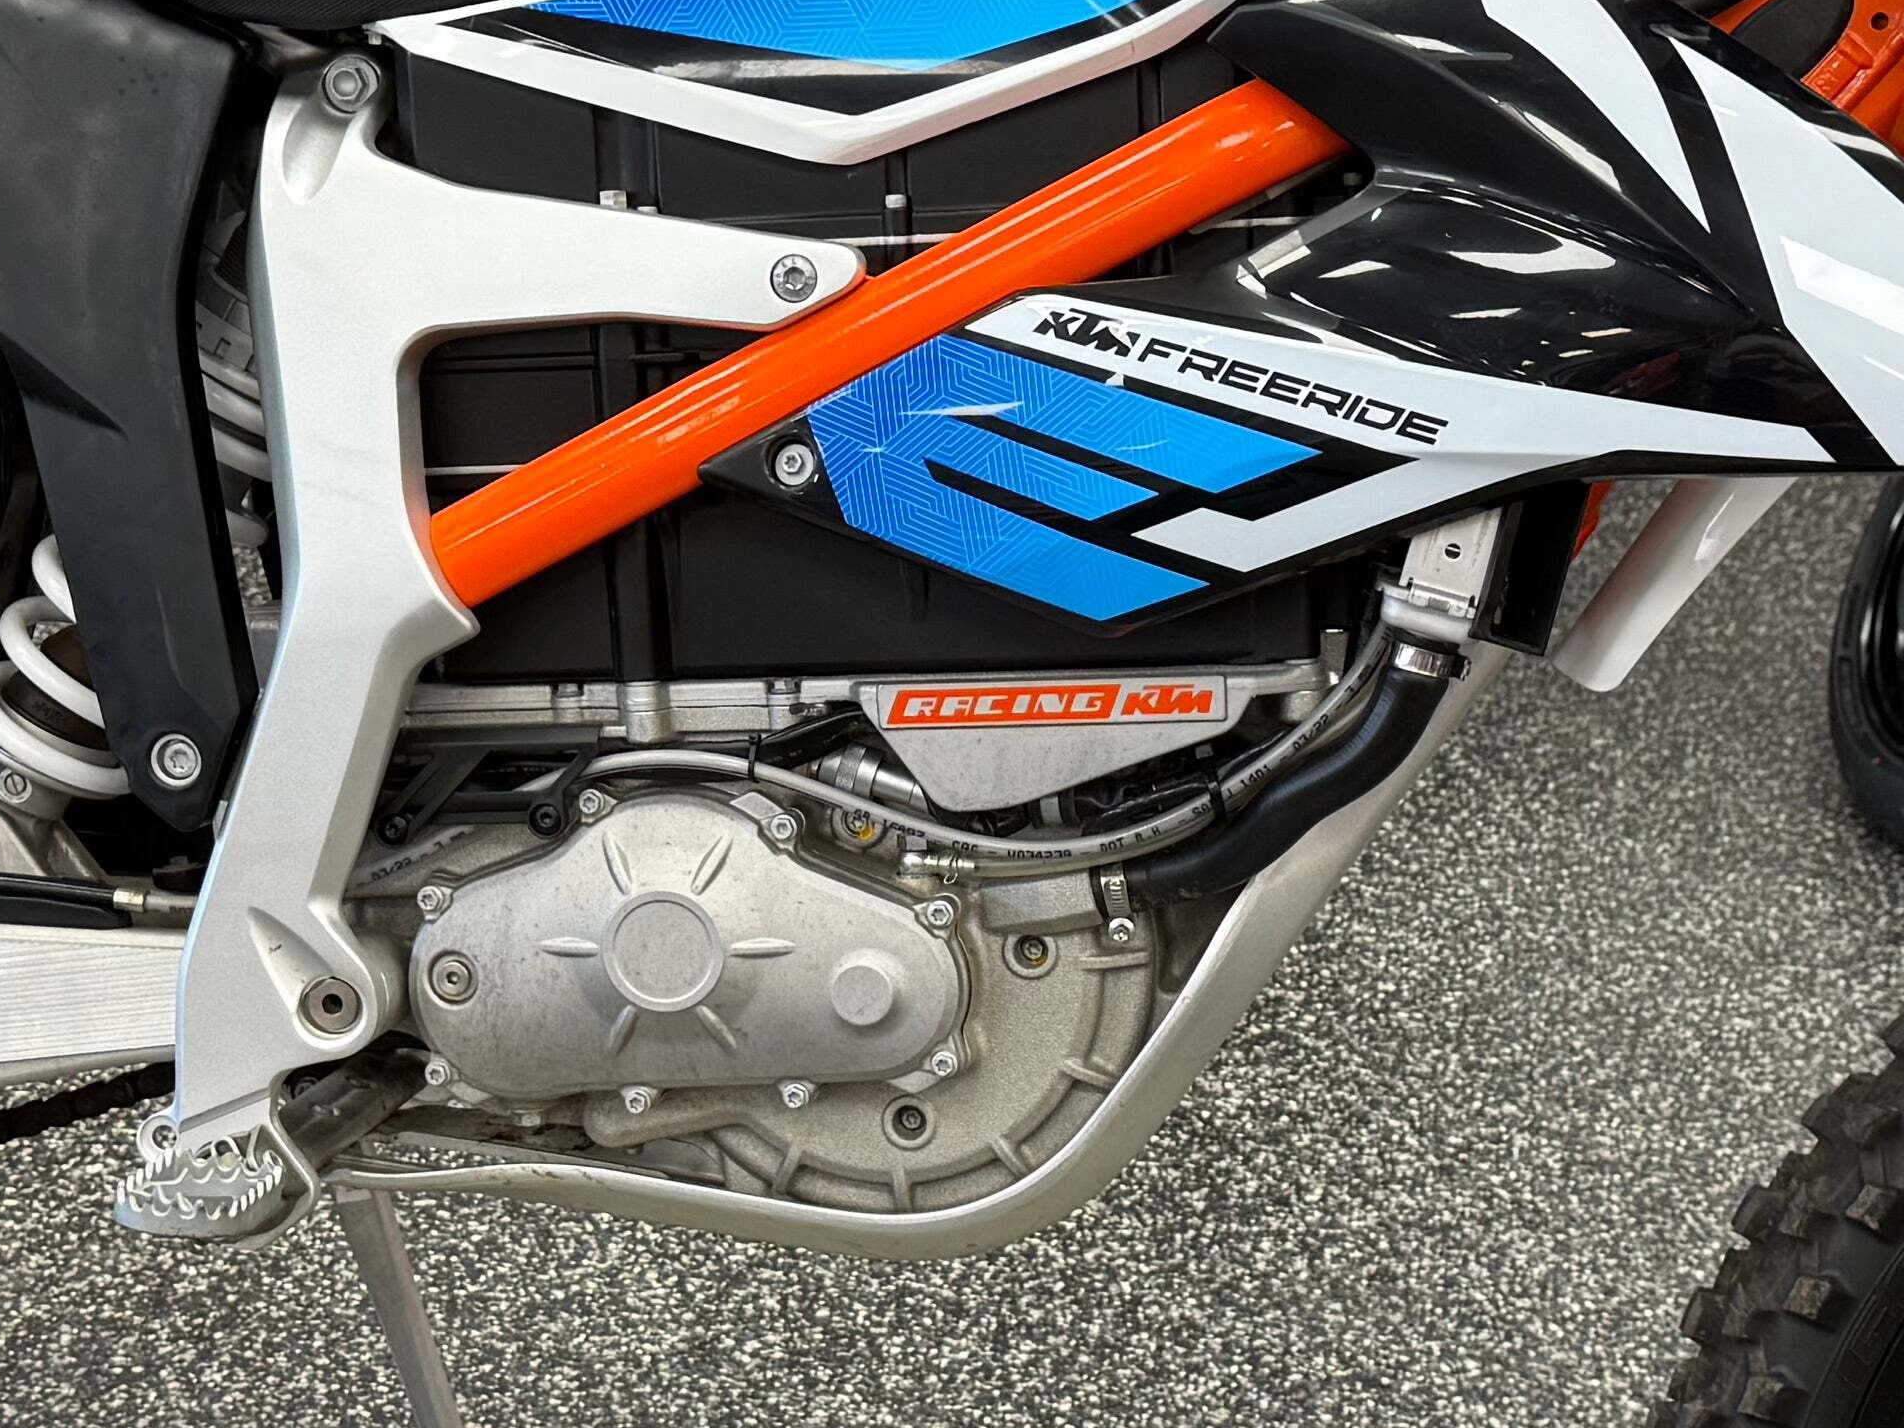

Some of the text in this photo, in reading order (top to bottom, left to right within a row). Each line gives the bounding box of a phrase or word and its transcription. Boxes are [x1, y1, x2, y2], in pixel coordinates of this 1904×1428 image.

[1033, 308, 1449, 445] KTM FREERIDE
[903, 683, 1213, 718] RACING KTM
[1239, 764, 1272, 789] 1401
